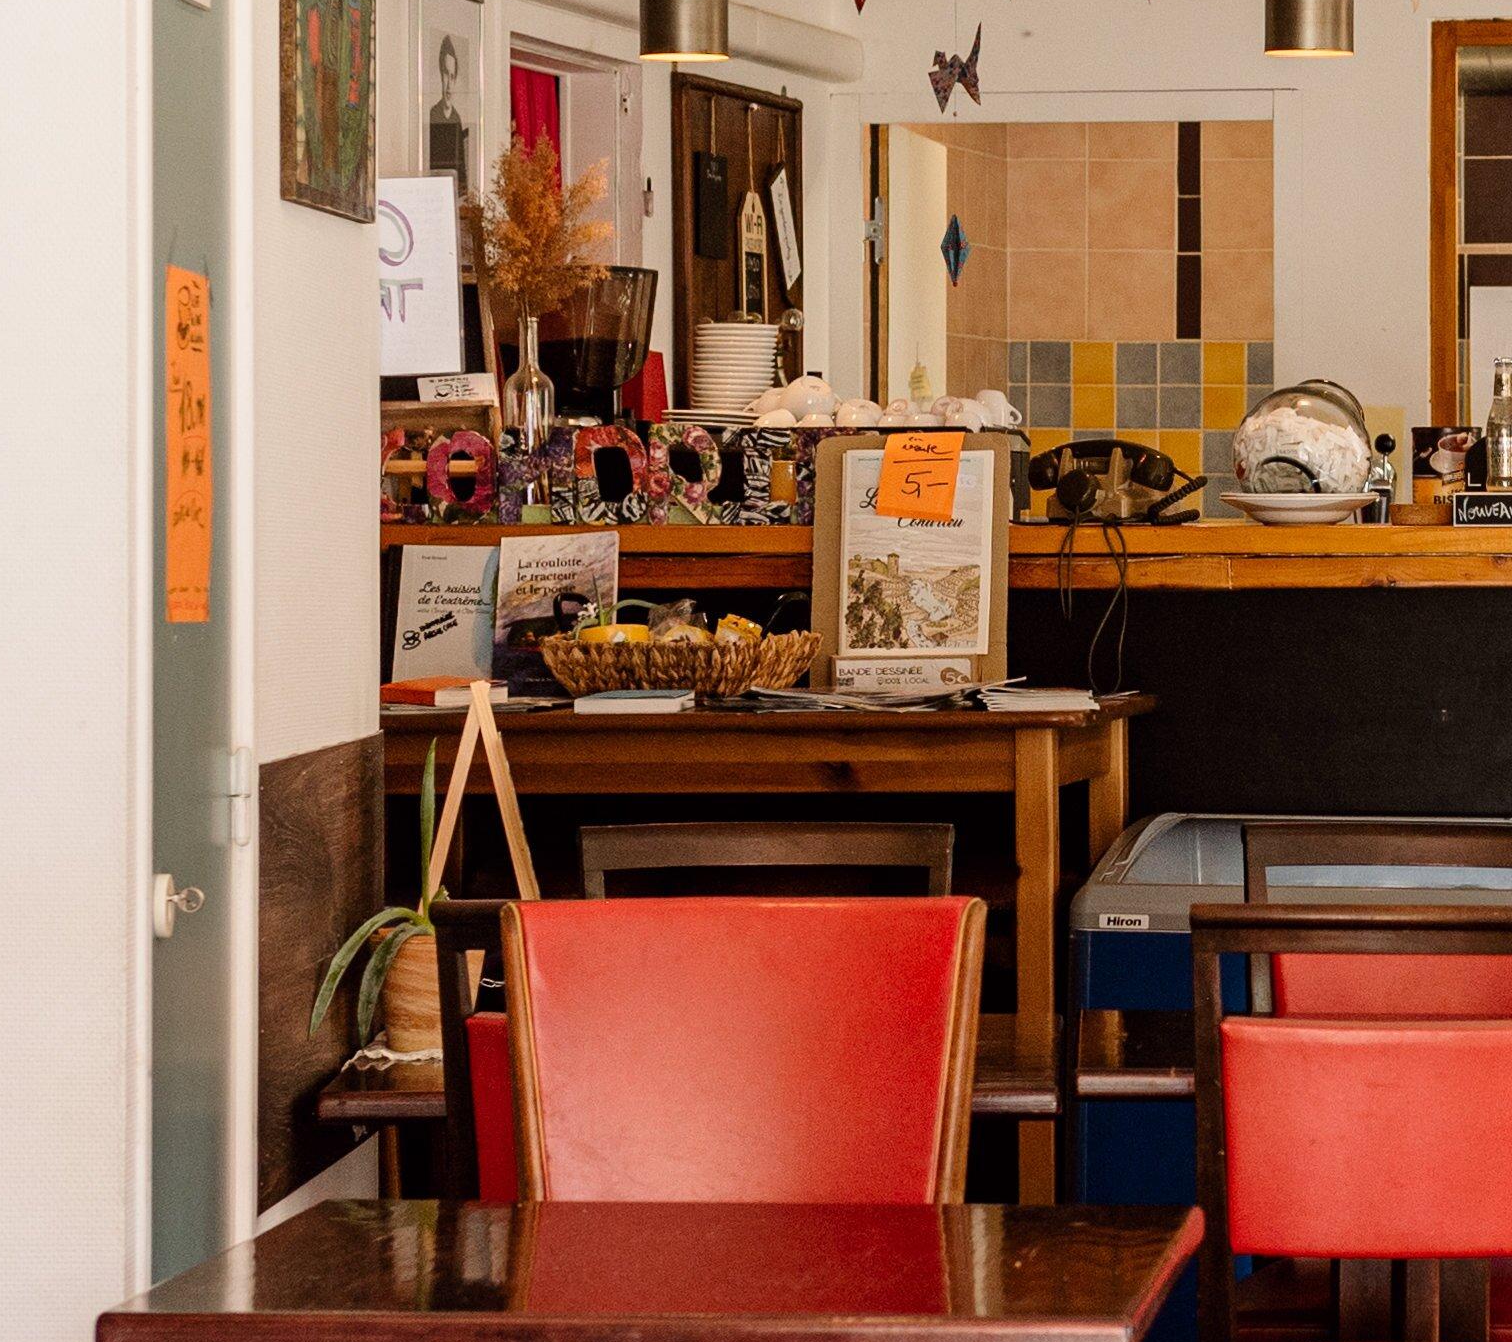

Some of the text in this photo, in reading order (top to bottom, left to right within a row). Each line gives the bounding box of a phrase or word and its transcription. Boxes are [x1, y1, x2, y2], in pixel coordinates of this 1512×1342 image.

[518, 558, 532, 569] La
[517, 571, 577, 582] le tracteur
[419, 580, 481, 594] Les raisins
[515, 586, 527, 595] et
[529, 584, 541, 595] le
[417, 595, 431, 605] de
[839, 665, 923, 676] BANDE DESSINÉE
[904, 676, 930, 684] LOCAL
[1106, 916, 1142, 927] Hiron
